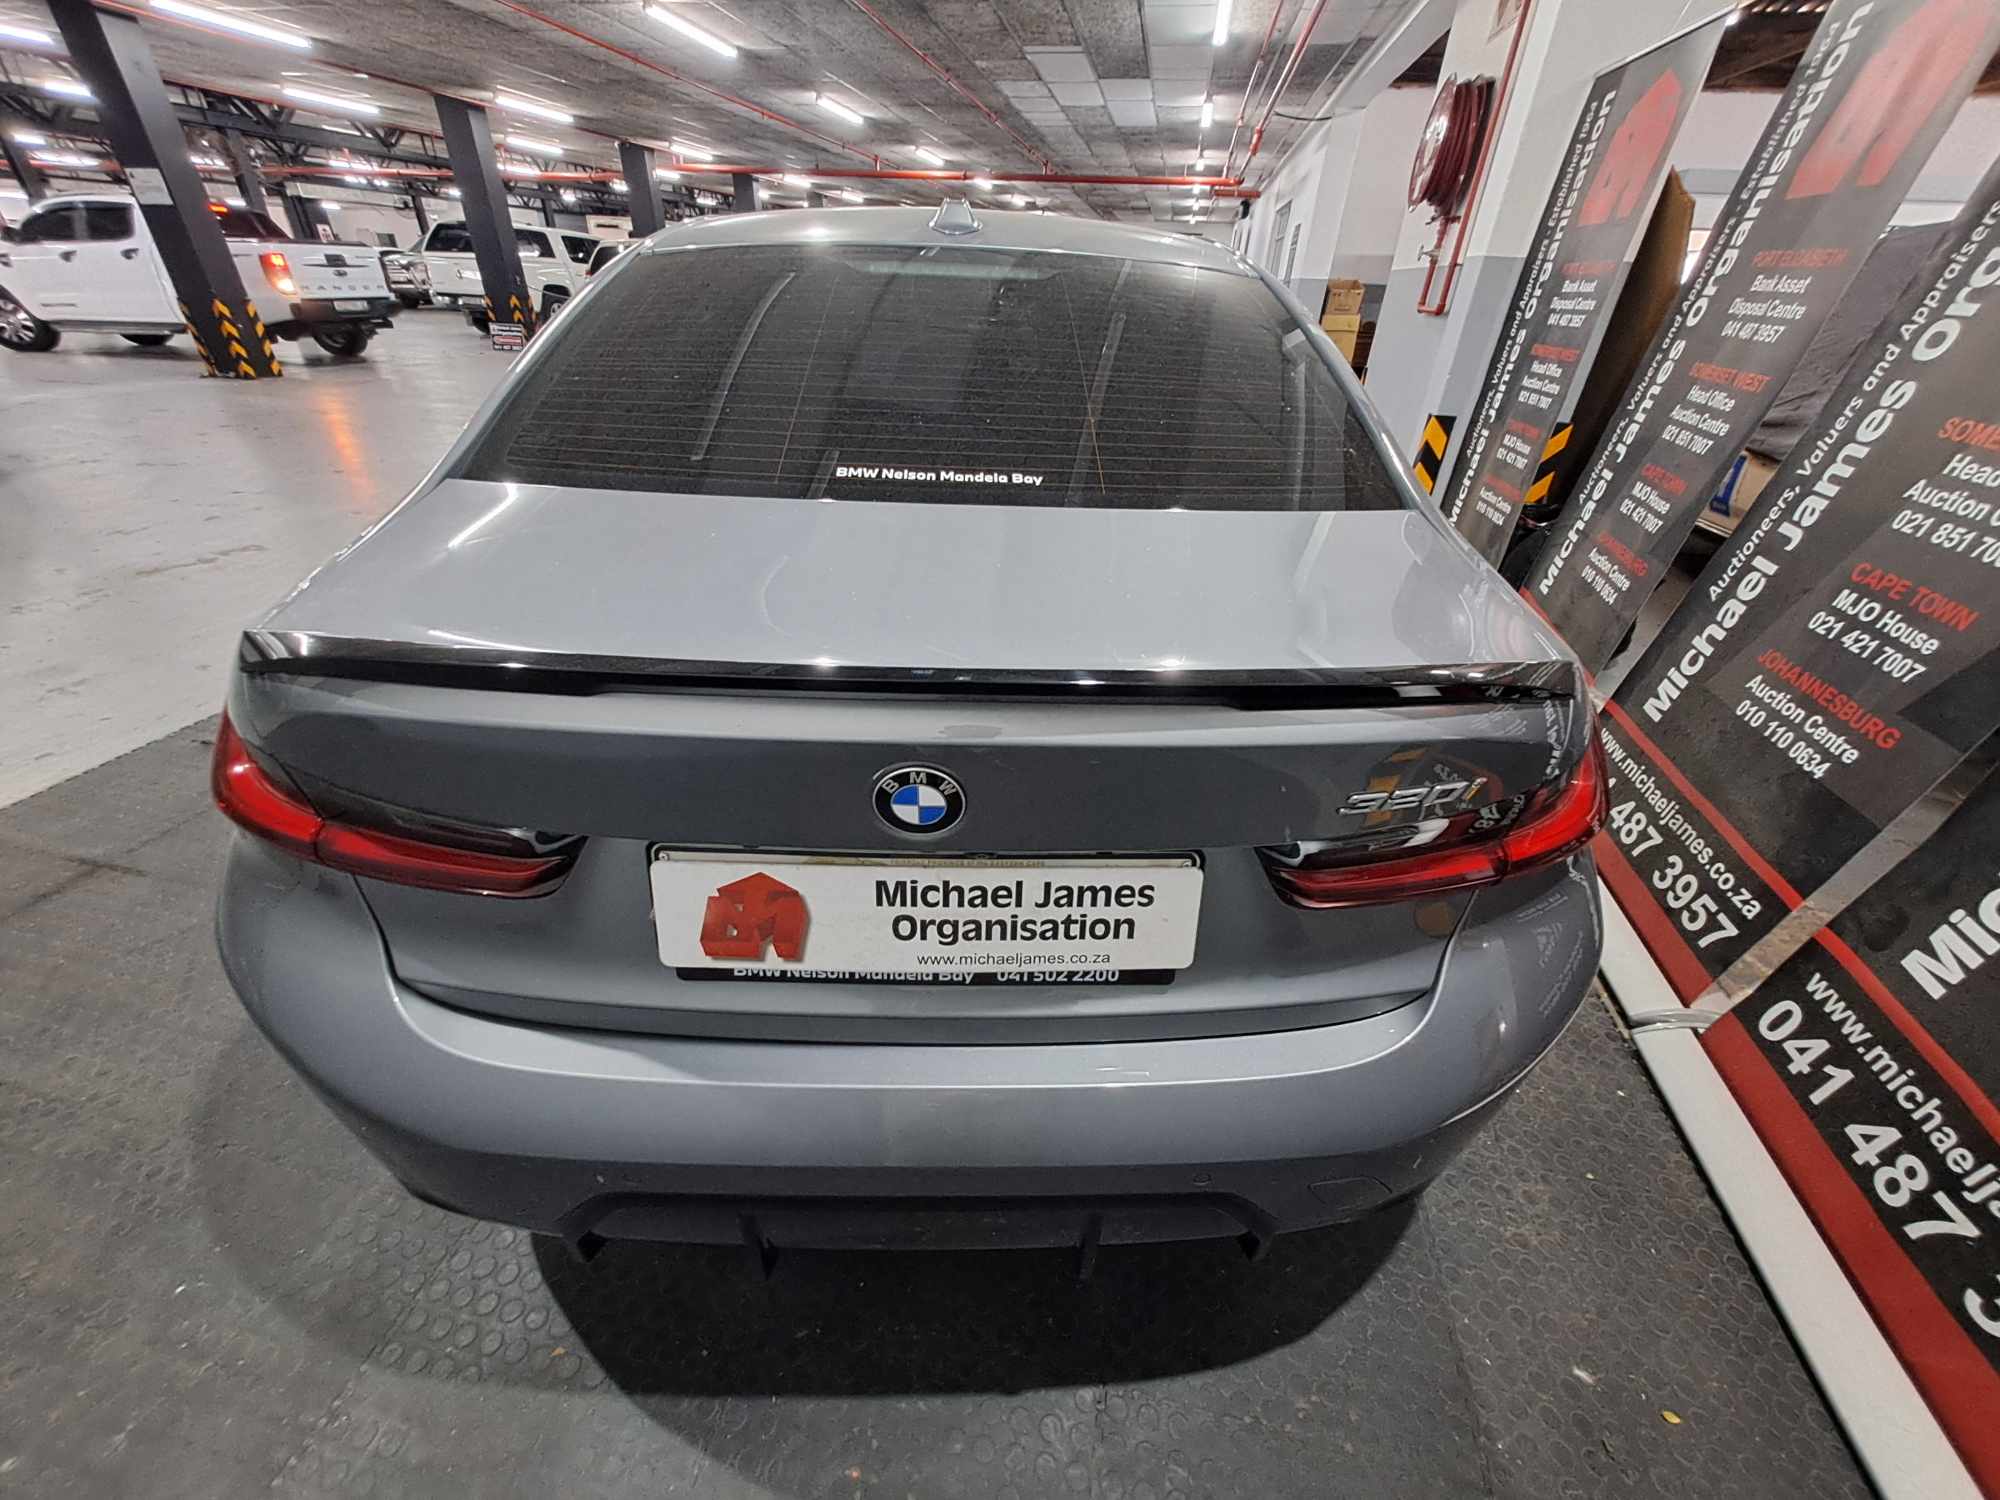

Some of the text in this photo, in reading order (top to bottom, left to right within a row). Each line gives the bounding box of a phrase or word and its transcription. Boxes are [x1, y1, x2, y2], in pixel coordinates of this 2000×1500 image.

[1491, 341, 1509, 384] Valuers
[1509, 311, 1522, 335] and
[1548, 143, 1583, 226] Established
[1539, 469, 1614, 596] Michael
[1616, 339, 1687, 463] James
[1686, 2, 1875, 328] Organisation
[1579, 417, 1629, 505] Auctioneers,
[1627, 353, 1662, 410] Valuers
[1661, 314, 1682, 349] and
[1680, 216, 1738, 313] Appraisers
[1740, 82, 1807, 200] Established
[1750, 274, 1813, 294] Bank Asset
[1449, 428, 1489, 527] Michael
[1488, 328, 1527, 424] James
[1525, 90, 1617, 319] Organisation
[1766, 299, 1807, 320] Centre
[1670, 404, 1731, 436] Auction Centre
[1686, 384, 1736, 412] Head Office
[1708, 200, 2000, 603] Auctioneers, Valuers and Appraisers
[836, 466, 1043, 487] BMW Nelson Mandela Bay
[1902, 479, 1993, 521] Auction
[1643, 555, 1780, 723] Michael
[1775, 379, 1918, 551] James
[1892, 509, 1936, 538] 021
[1930, 522, 1978, 552] 851
[1832, 589, 1940, 655] MJO House
[1851, 562, 1981, 632] CAPE TOWN
[1808, 611, 1927, 683] 021 421 7007
[1745, 674, 1860, 764] Auction Centre
[1757, 649, 1902, 750] JOHANNESBURG
[1735, 700, 1832, 779] 010 110 0634
[1600, 727, 1762, 920] www.michaeljames.co.za
[875, 880, 1156, 909] Michael James
[1609, 800, 1740, 949] 487 3957
[892, 914, 1136, 946] Organisation
[917, 952, 1111, 968] www.michaeljames.co.za
[1758, 1000, 1982, 1240] 041 487
